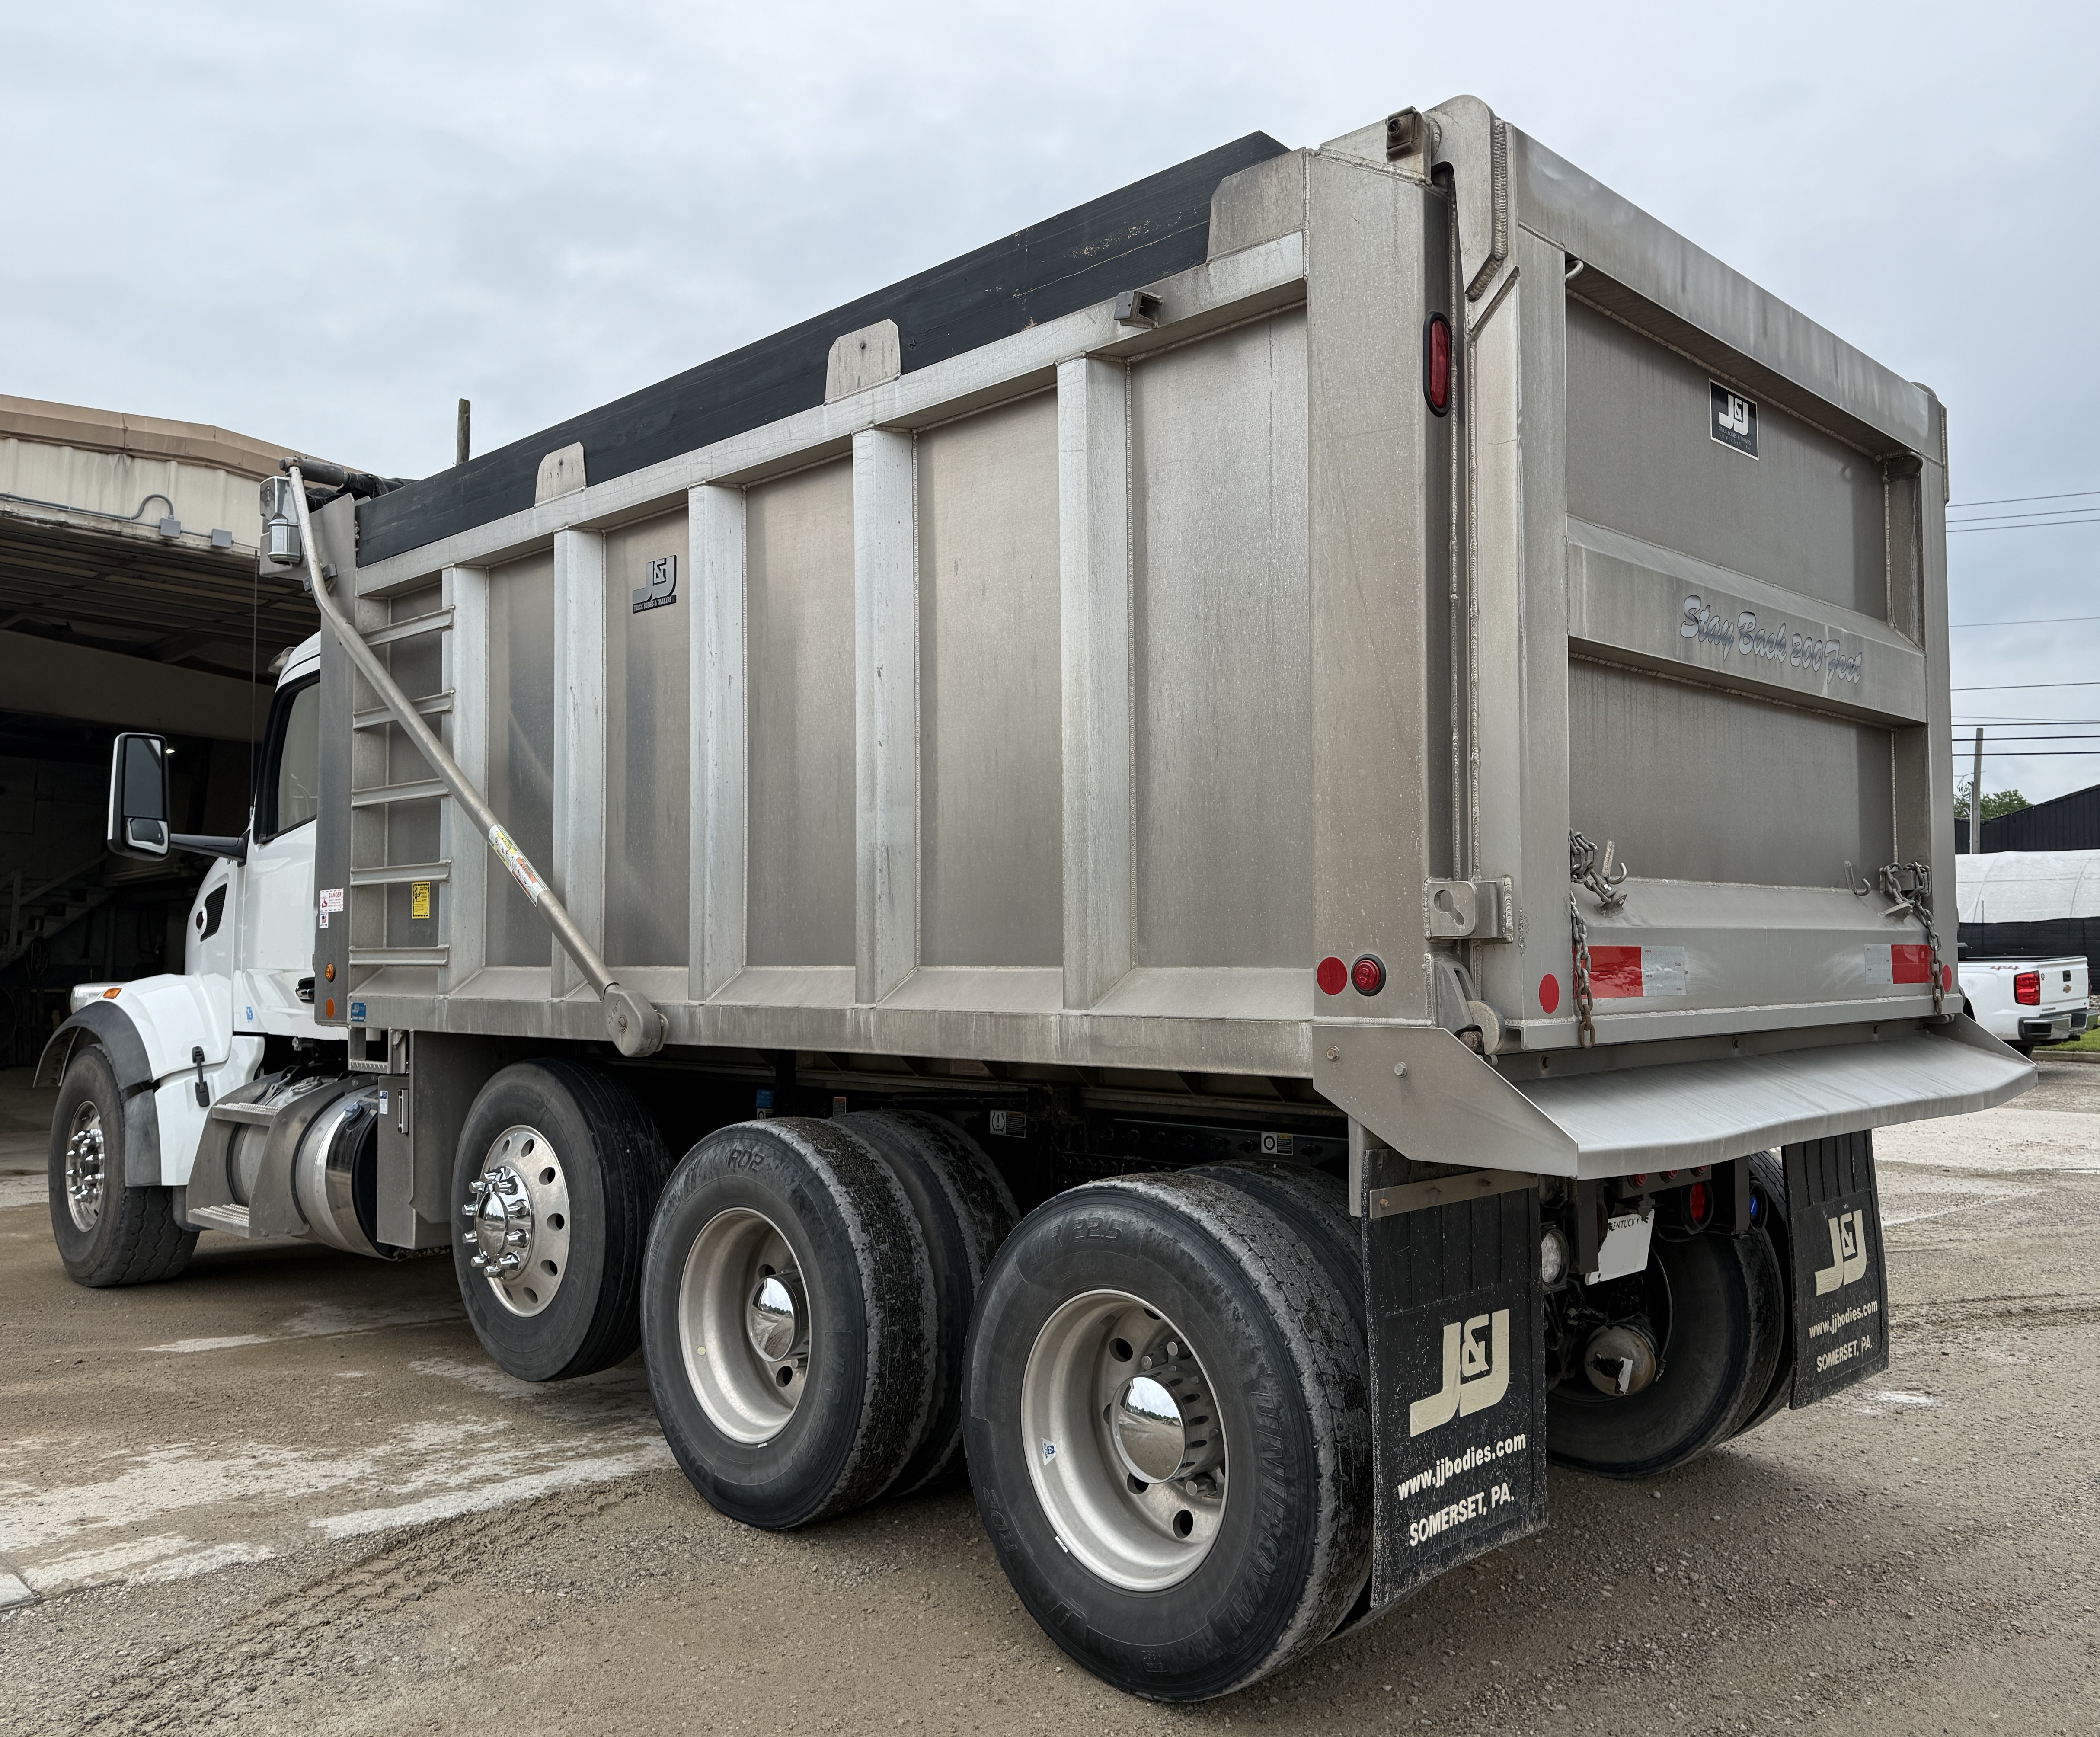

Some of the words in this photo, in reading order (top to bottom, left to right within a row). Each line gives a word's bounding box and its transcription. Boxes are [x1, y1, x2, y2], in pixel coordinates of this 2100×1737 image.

[1719, 394, 1748, 436] J&J
[633, 555, 677, 605] J&J
[1681, 595, 1734, 661] Stay
[1737, 611, 1787, 663] Back
[1790, 633, 1823, 672] 200
[1824, 639, 1863, 684] Feet
[1071, 1217, 1127, 1244] 22.5
[1814, 1209, 1867, 1296] J&J
[1809, 1300, 1878, 1339] www.jjbodies.com
[1410, 1308, 1509, 1437] J&J
[1816, 1340, 1859, 1372] SOMERSET,
[1861, 1335, 1873, 1352] PA.
[1397, 1433, 1526, 1500] www.jjbodies.com
[1410, 1492, 1487, 1547] SOMERSET,
[1491, 1482, 1515, 1509] PA.
